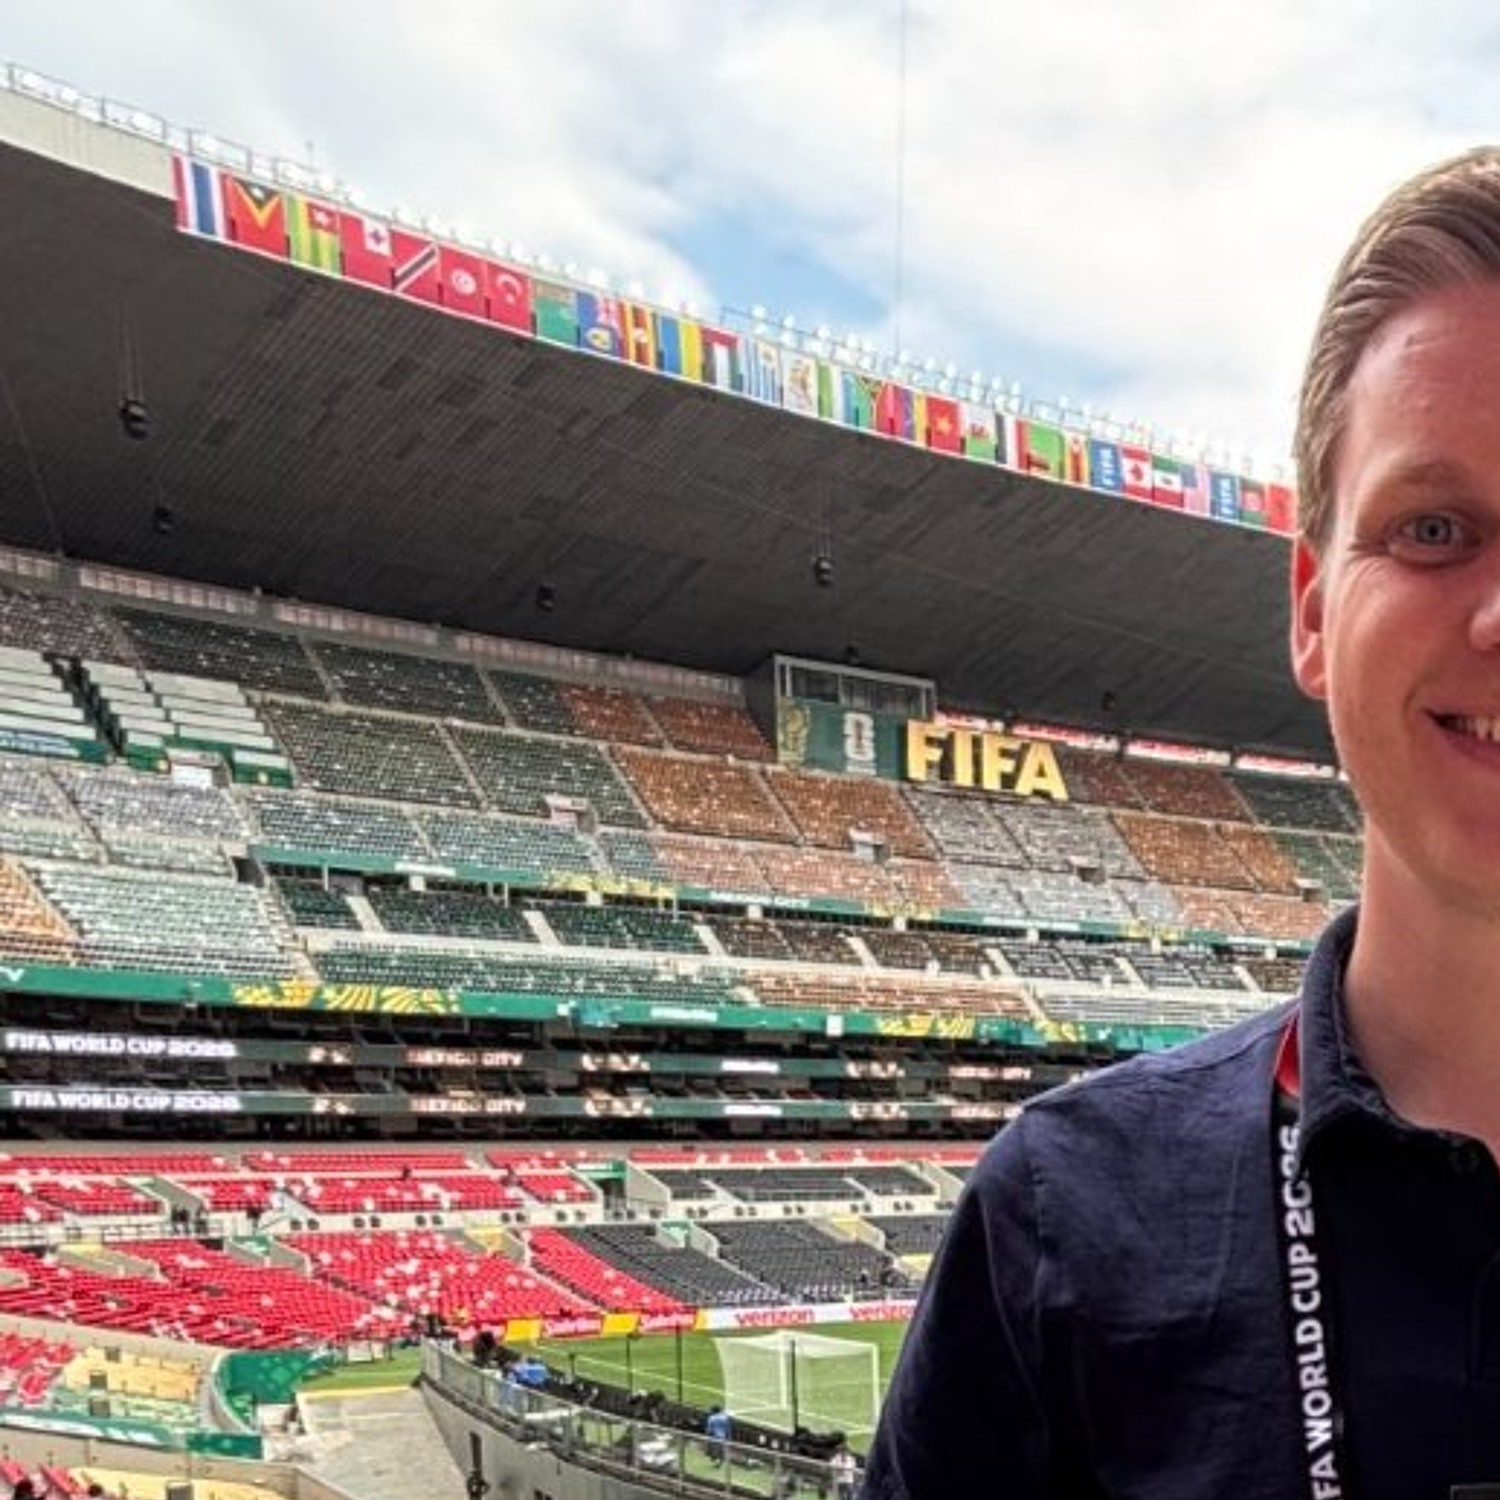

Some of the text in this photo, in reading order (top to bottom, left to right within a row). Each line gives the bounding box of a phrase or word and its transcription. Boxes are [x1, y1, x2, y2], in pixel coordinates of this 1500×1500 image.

[907, 719, 1069, 800] FIFA
[5, 1032, 50, 1050] FIFA
[52, 1035, 125, 1052] WORLD
[127, 1038, 166, 1054] CUP
[11, 1090, 55, 1108] FIFA
[58, 1092, 131, 1109] WORLD
[133, 1094, 170, 1110] CUP
[1289, 1243, 1321, 1312] CUP
[734, 1309, 816, 1327] verizon
[849, 1305, 914, 1322] verizo
[1296, 1319, 1332, 1452] WORLD
